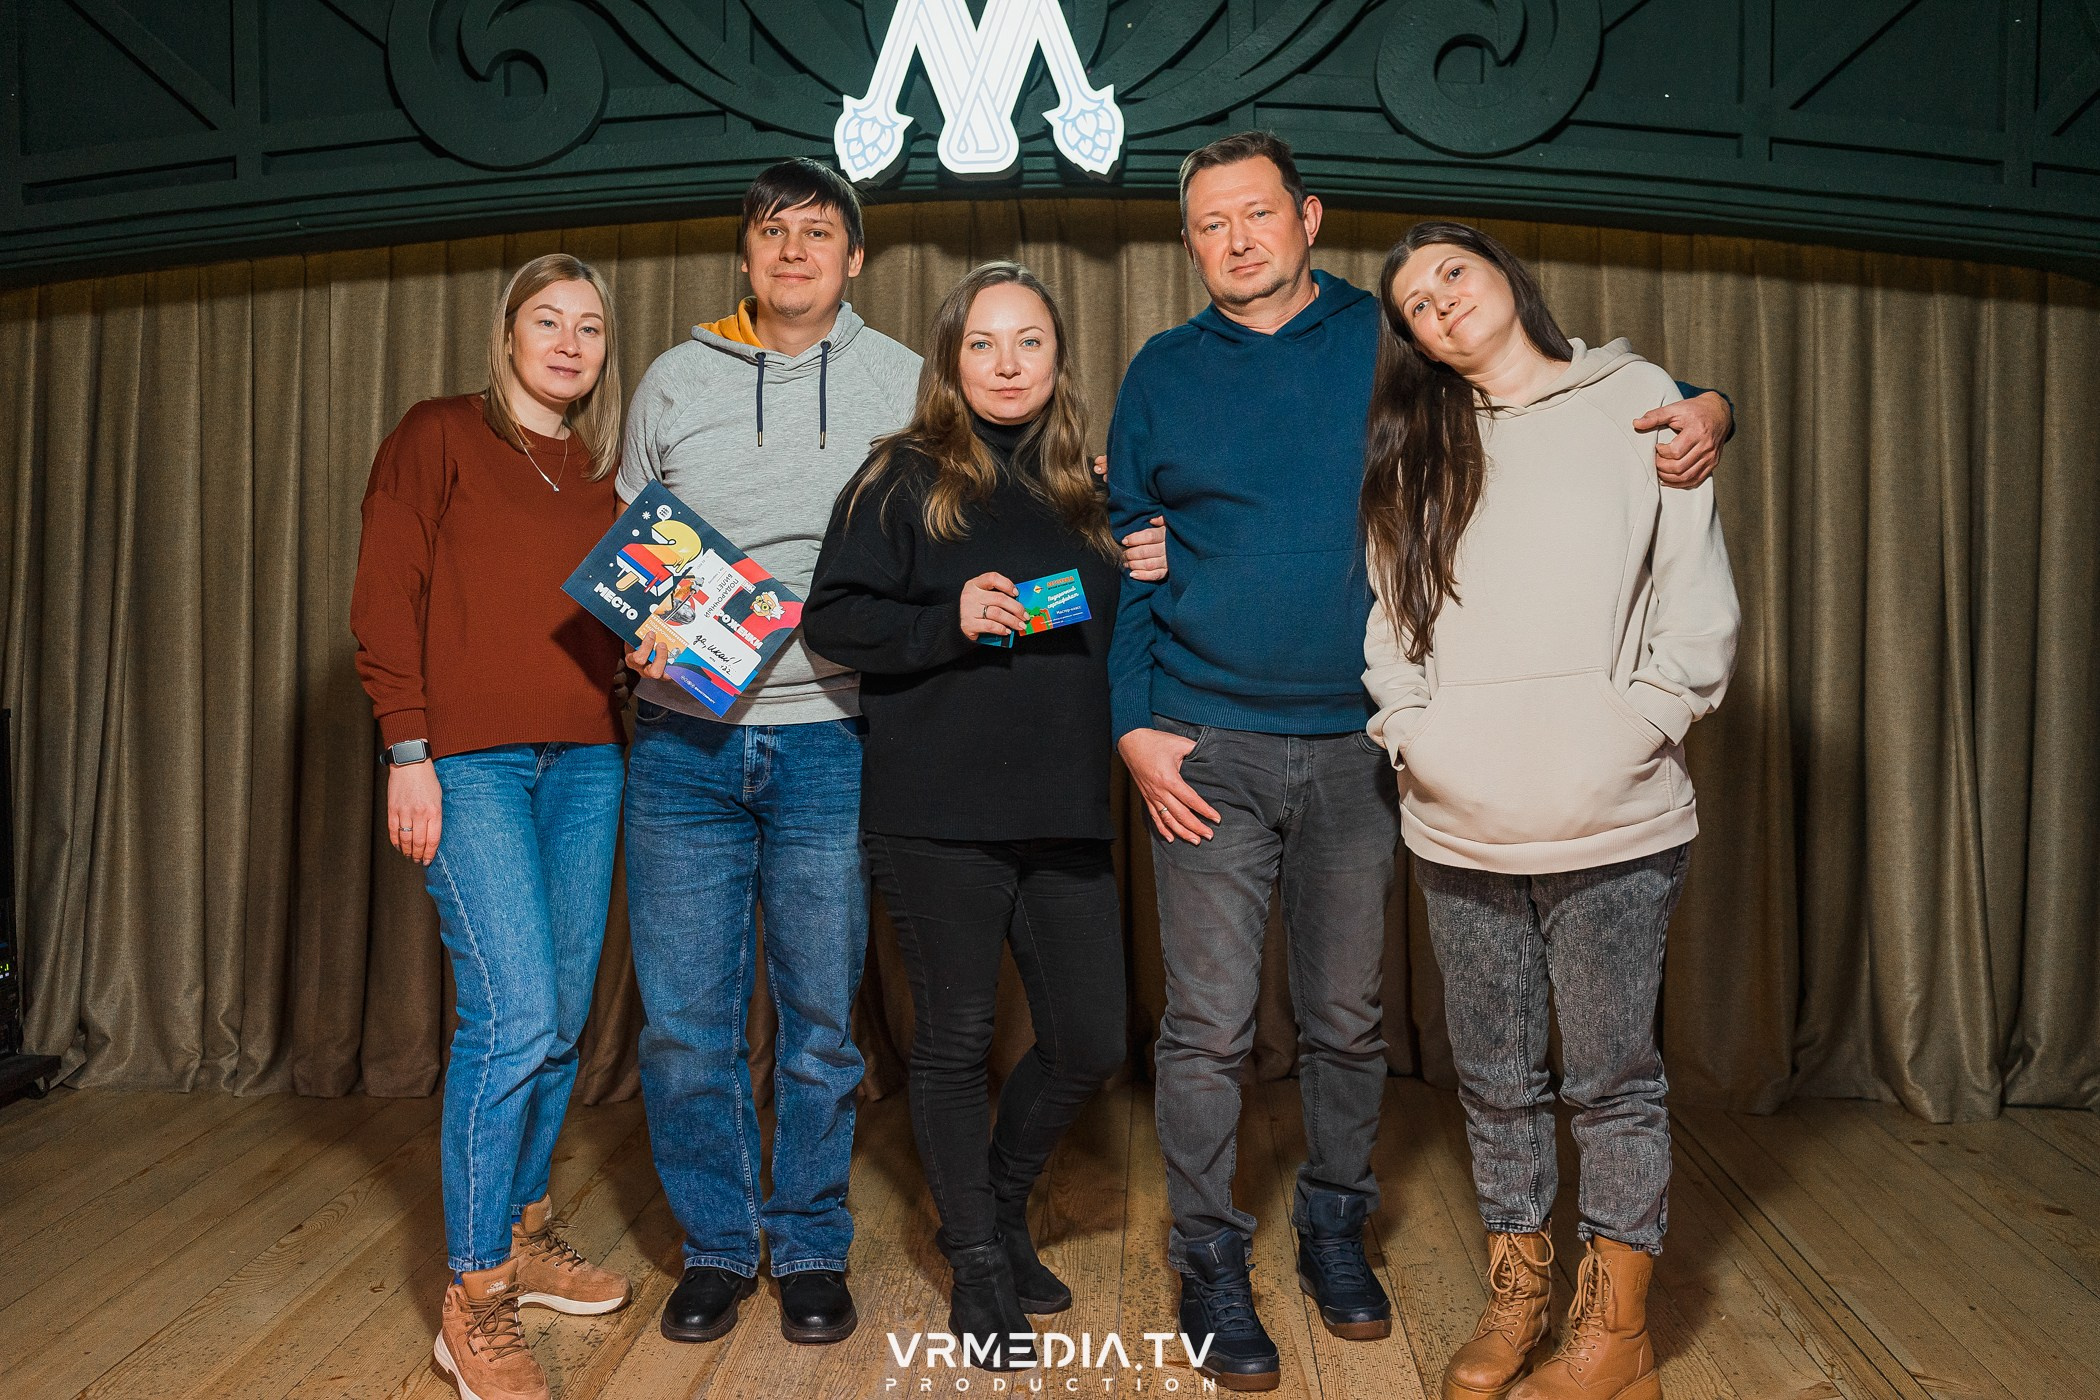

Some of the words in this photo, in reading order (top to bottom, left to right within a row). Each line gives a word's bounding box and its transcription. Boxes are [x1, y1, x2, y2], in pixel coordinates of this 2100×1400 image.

[593, 581, 638, 620] МЕСТО
[704, 579, 739, 618] ПОДАРОЧНЫЙ
[717, 573, 733, 592] БИЛЕТ
